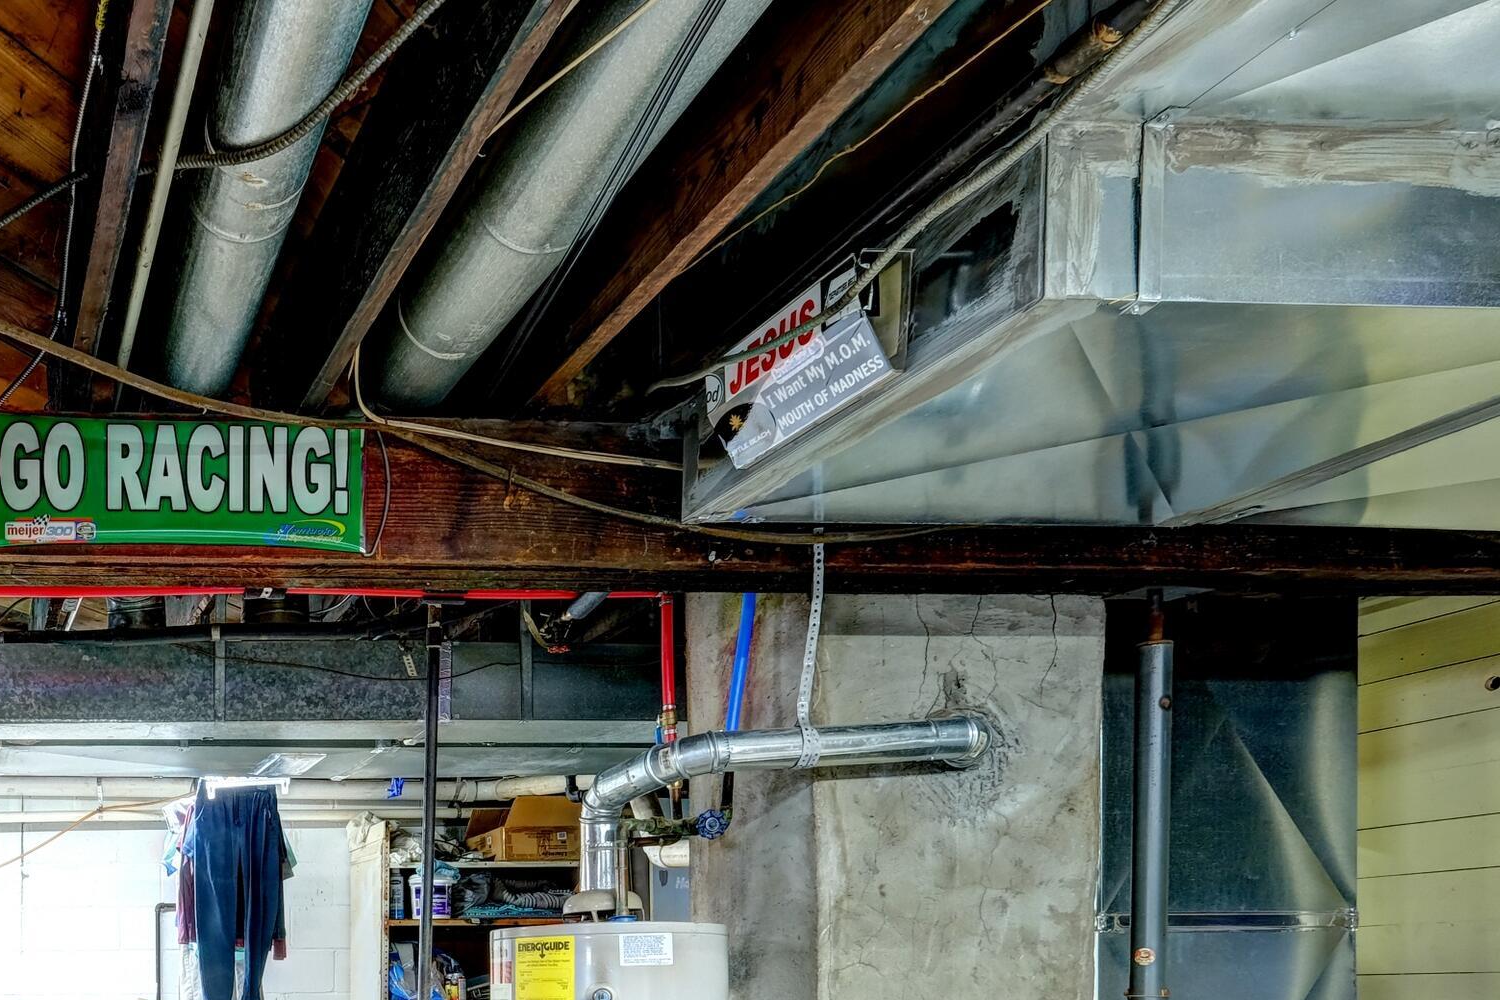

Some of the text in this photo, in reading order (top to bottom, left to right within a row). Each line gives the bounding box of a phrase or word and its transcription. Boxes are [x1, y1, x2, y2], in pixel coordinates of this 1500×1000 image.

[729, 299, 815, 395] JESUS
[766, 393, 776, 409] I
[773, 376, 807, 405] Want
[806, 361, 827, 385] My
[826, 332, 871, 373] M.O.M.
[777, 401, 815, 431] MOUTH
[814, 389, 830, 408] OF
[830, 354, 885, 398] MADNESS
[0, 421, 350, 516] GO RACING!
[7, 523, 44, 538] meijer
[46, 526, 73, 536] 300
